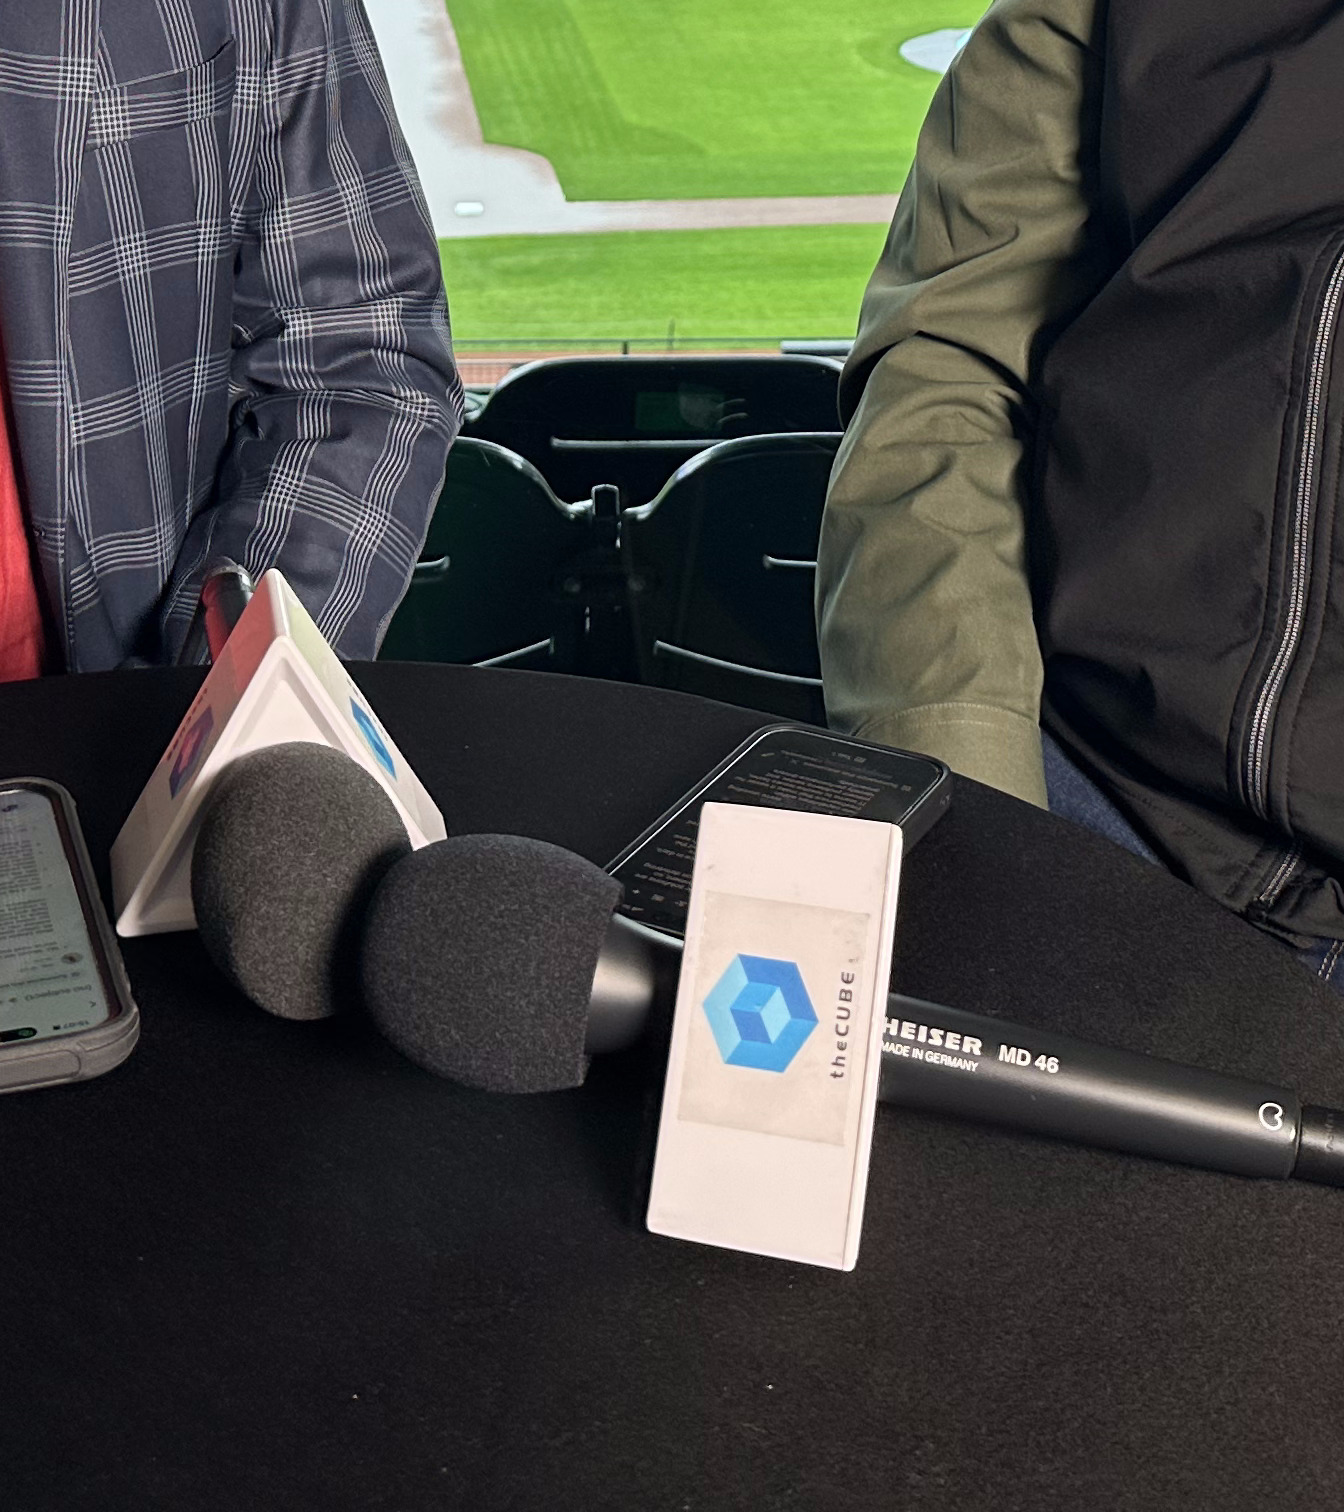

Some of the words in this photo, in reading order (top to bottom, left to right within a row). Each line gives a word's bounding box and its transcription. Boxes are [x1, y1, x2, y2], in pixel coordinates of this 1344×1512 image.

[882, 1040, 910, 1058] MADE
[912, 1047, 924, 1061] IN
[924, 1050, 979, 1073] GERMANY
[998, 1043, 1031, 1066] MD
[1034, 1054, 1060, 1074] 46
